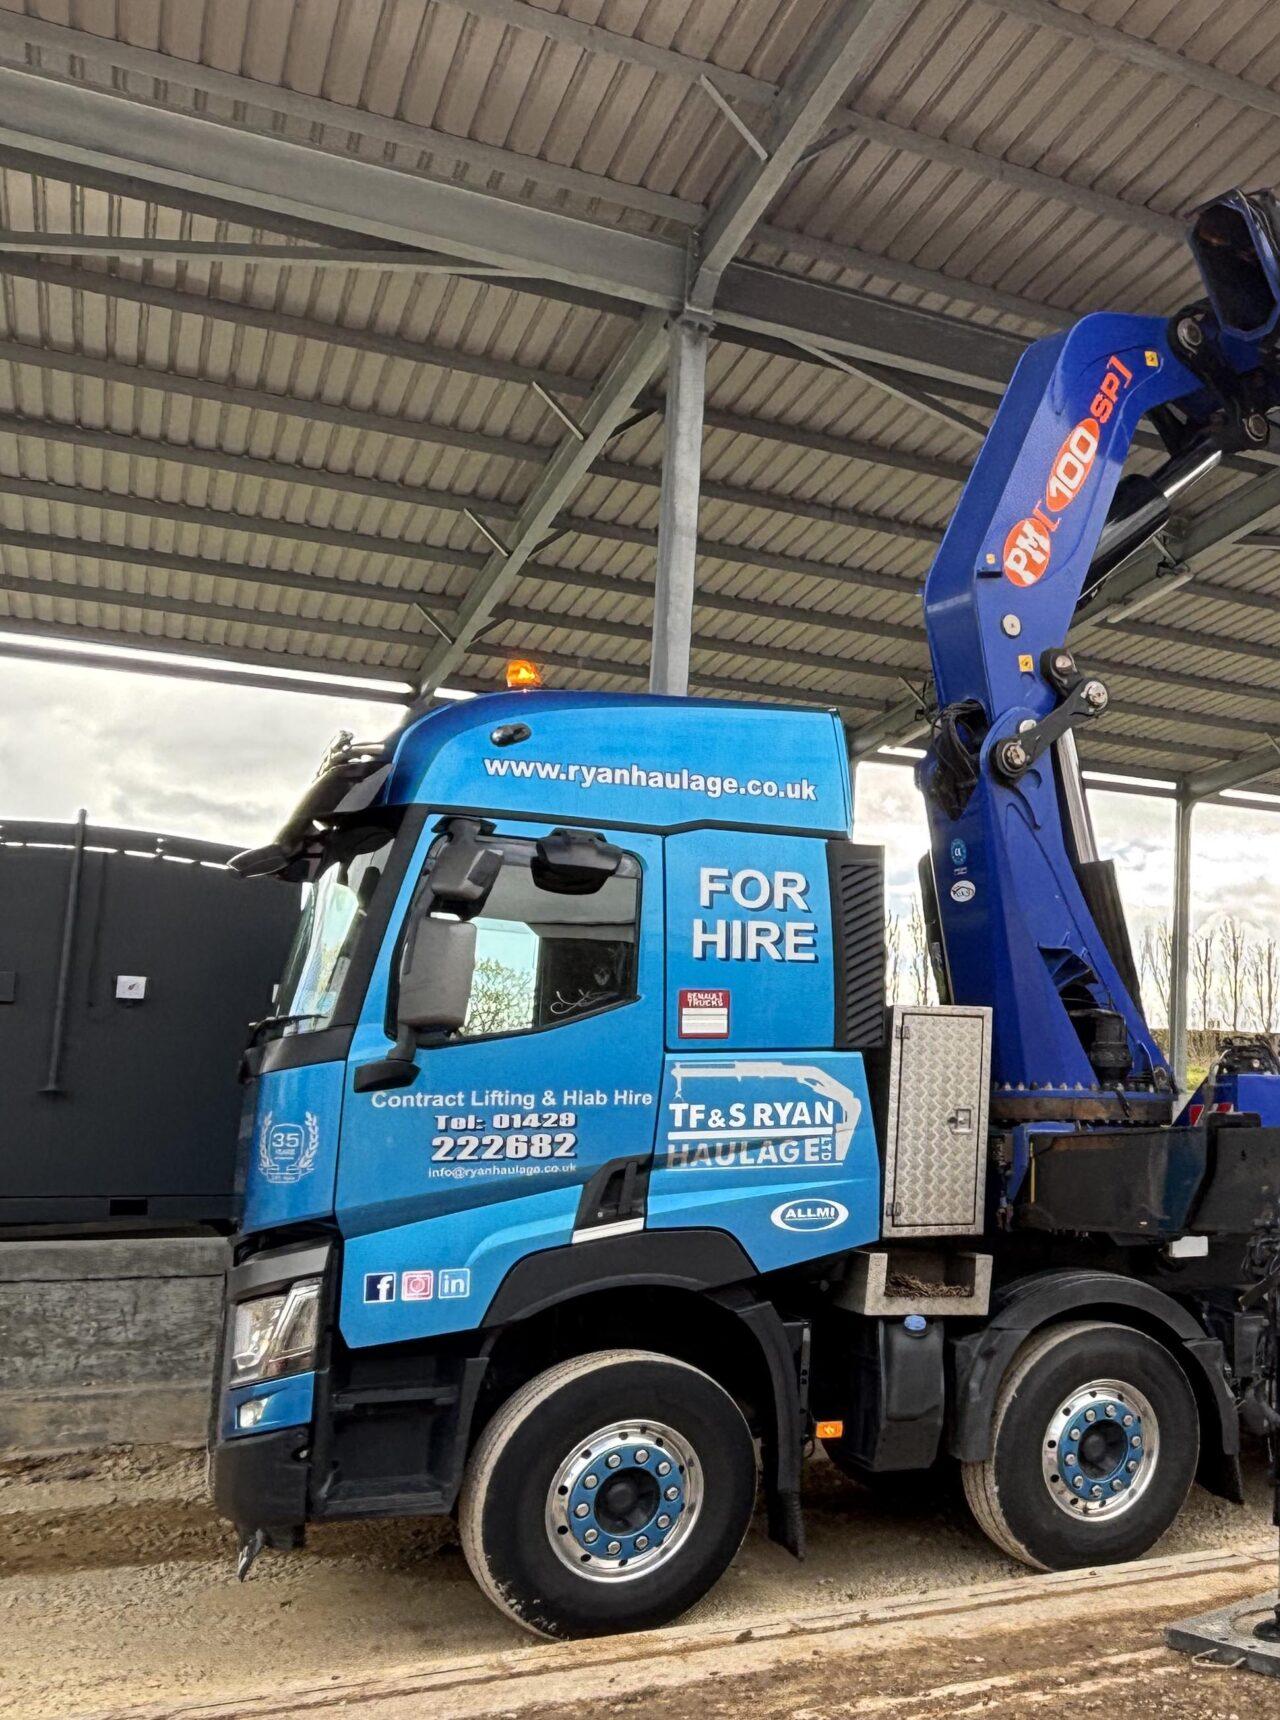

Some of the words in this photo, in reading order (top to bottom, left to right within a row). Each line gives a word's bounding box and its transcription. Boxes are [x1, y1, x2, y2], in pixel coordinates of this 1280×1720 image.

[1005, 521, 1050, 585] PM
[1049, 426, 1097, 500] 100
[483, 758, 817, 800] www.ryanhaulage.co.uk
[700, 867, 811, 912] FOR
[692, 919, 817, 962] HIRE
[687, 999, 724, 1007] TRUCKS
[371, 1090, 465, 1108] Contract
[471, 1090, 536, 1110] Lifting
[542, 1090, 557, 1106] &
[614, 1089, 652, 1105] Hire
[753, 1101, 834, 1127] RYAN
[272, 1132, 300, 1147] 35
[431, 1133, 577, 1162] 222682
[821, 1137, 832, 1161] LTD
[667, 1138, 820, 1168] HAULAGE
[428, 1162, 577, 1180] info@ryanhaulage.co.uk
[785, 1207, 835, 1219] ALLMI
